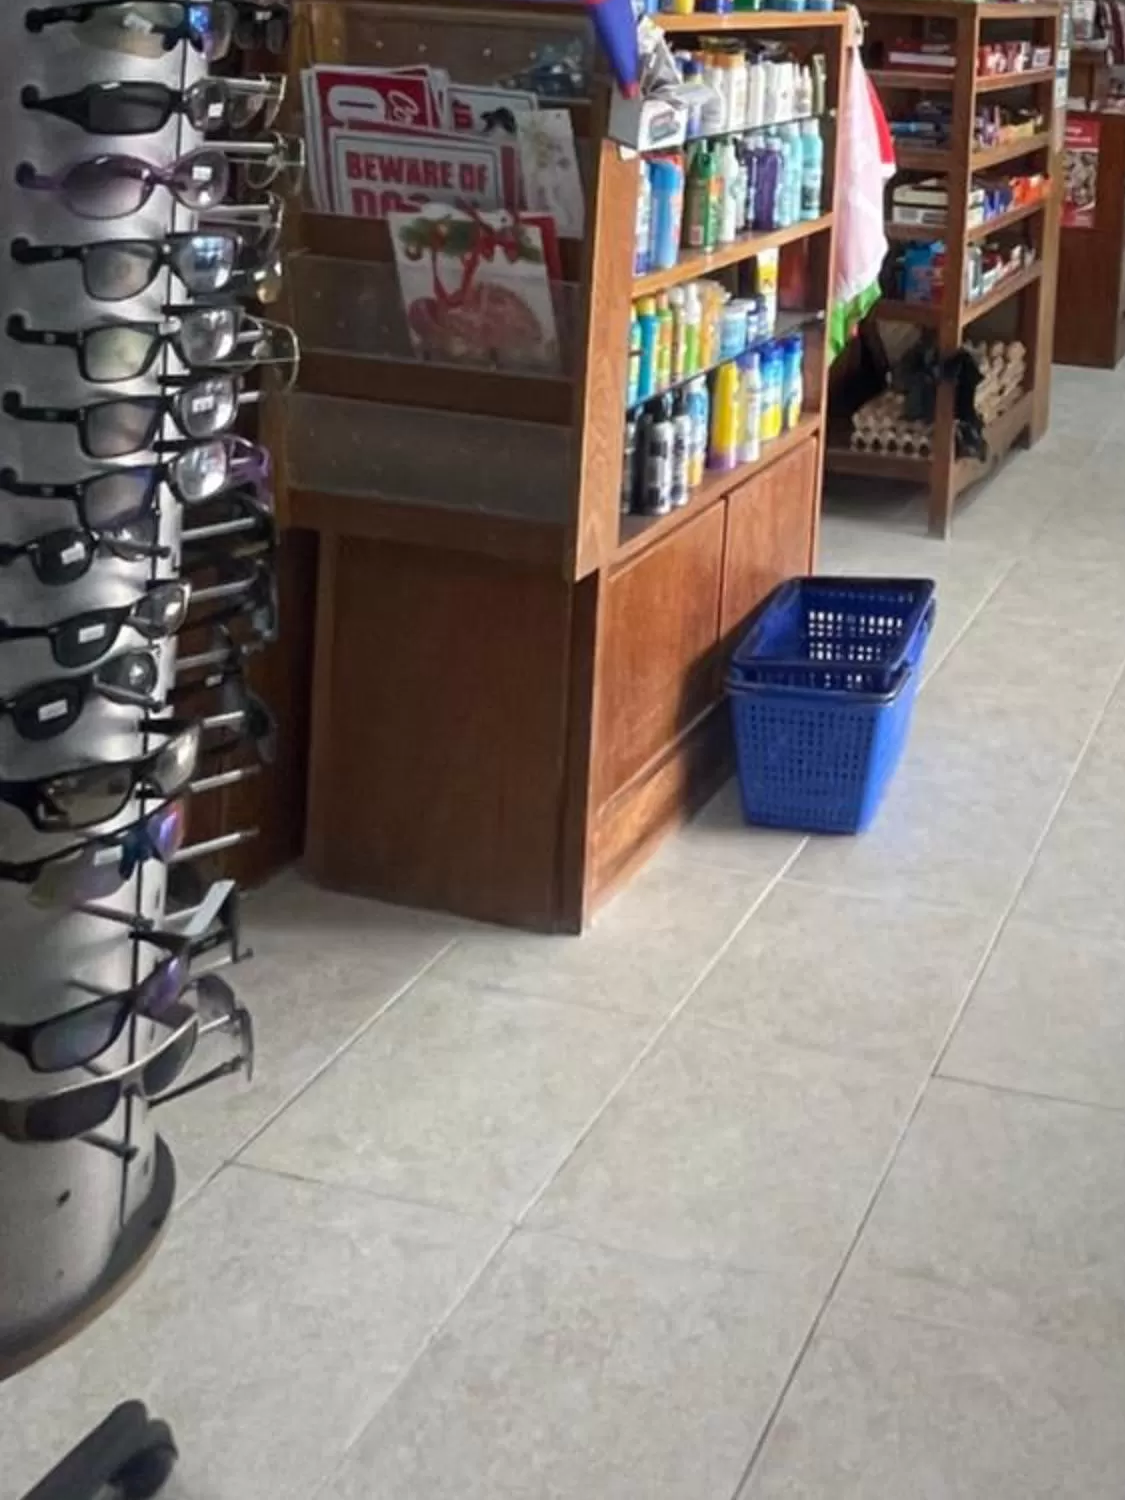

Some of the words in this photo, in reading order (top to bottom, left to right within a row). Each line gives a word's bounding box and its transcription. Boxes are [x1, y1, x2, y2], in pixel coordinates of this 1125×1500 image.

[346, 151, 453, 188] BEWARE
[459, 163, 488, 193] OF
[351, 188, 430, 216] DO
